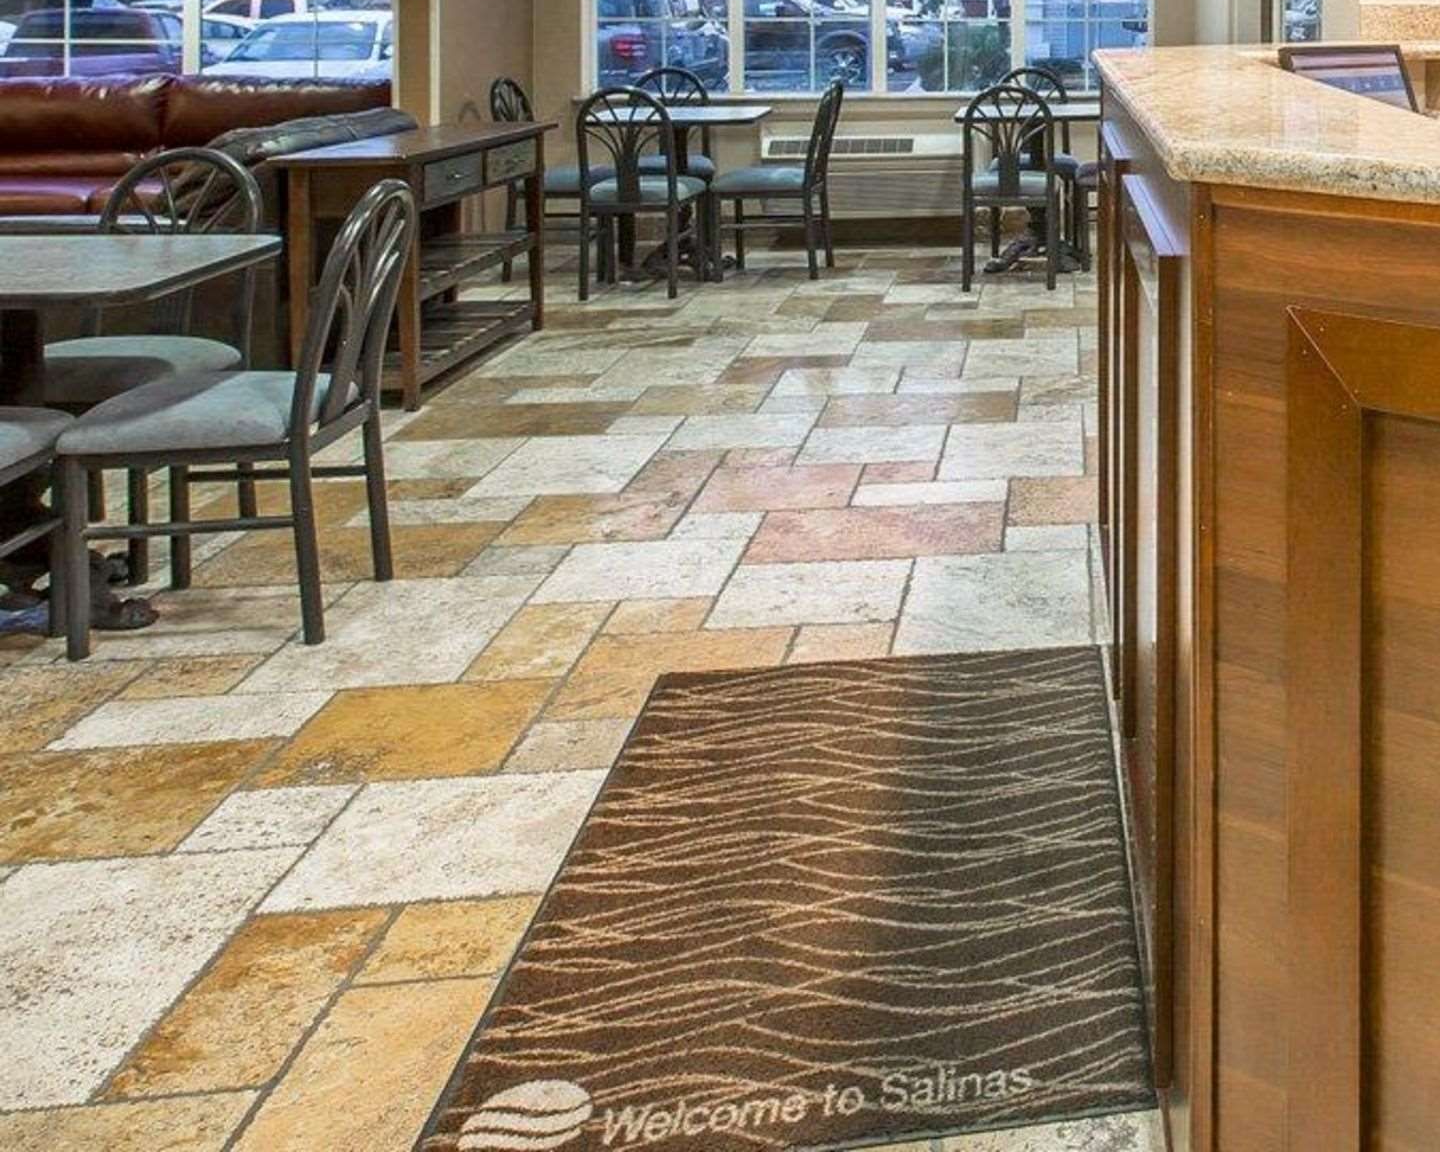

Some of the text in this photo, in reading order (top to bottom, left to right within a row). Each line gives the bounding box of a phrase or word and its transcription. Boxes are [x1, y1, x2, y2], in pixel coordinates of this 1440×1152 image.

[602, 1066, 1034, 1146] Welcome to Salinas
